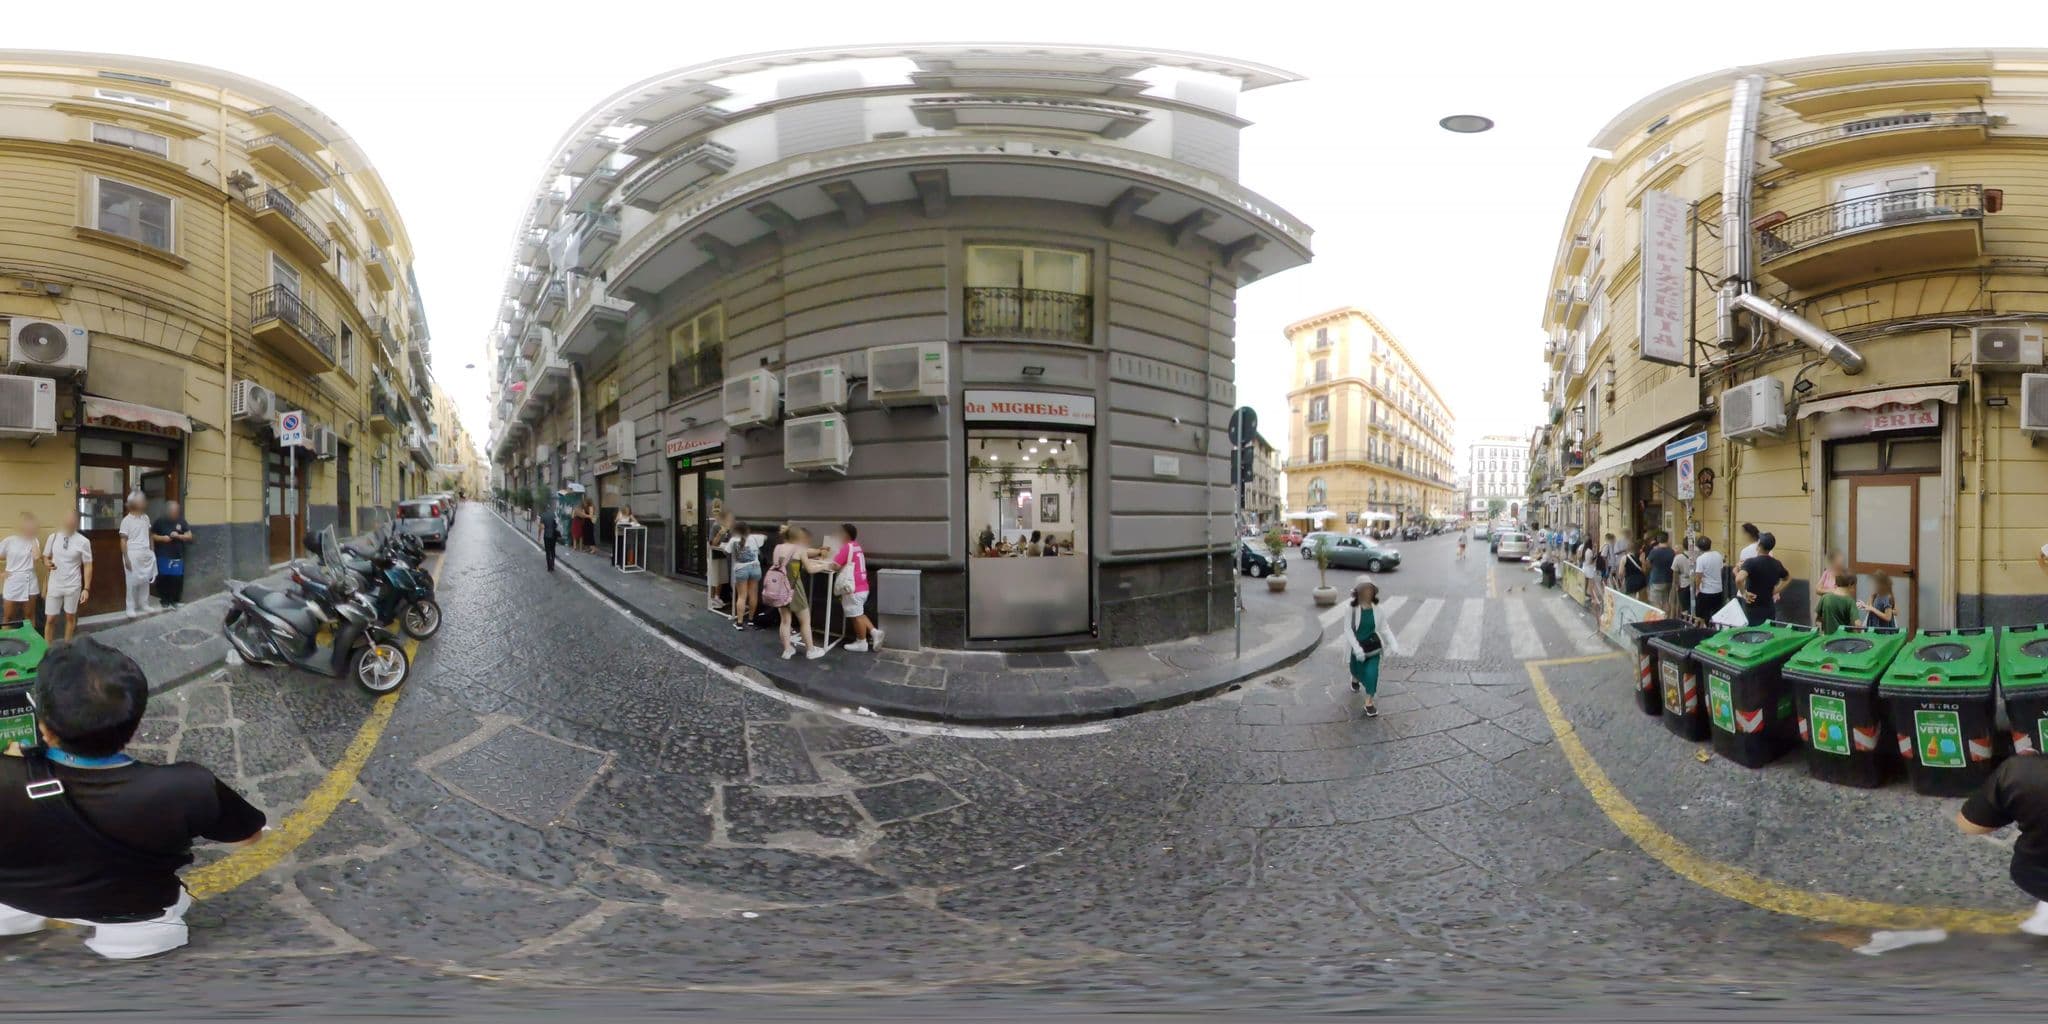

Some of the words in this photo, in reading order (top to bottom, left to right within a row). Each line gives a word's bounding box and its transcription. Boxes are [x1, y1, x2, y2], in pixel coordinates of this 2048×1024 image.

[990, 402, 1069, 417] MICHELE
[1812, 687, 1846, 698] VETRO
[0, 706, 32, 716] ETRO
[1813, 709, 1844, 722] VETRO
[1920, 726, 1957, 735] VETRO
